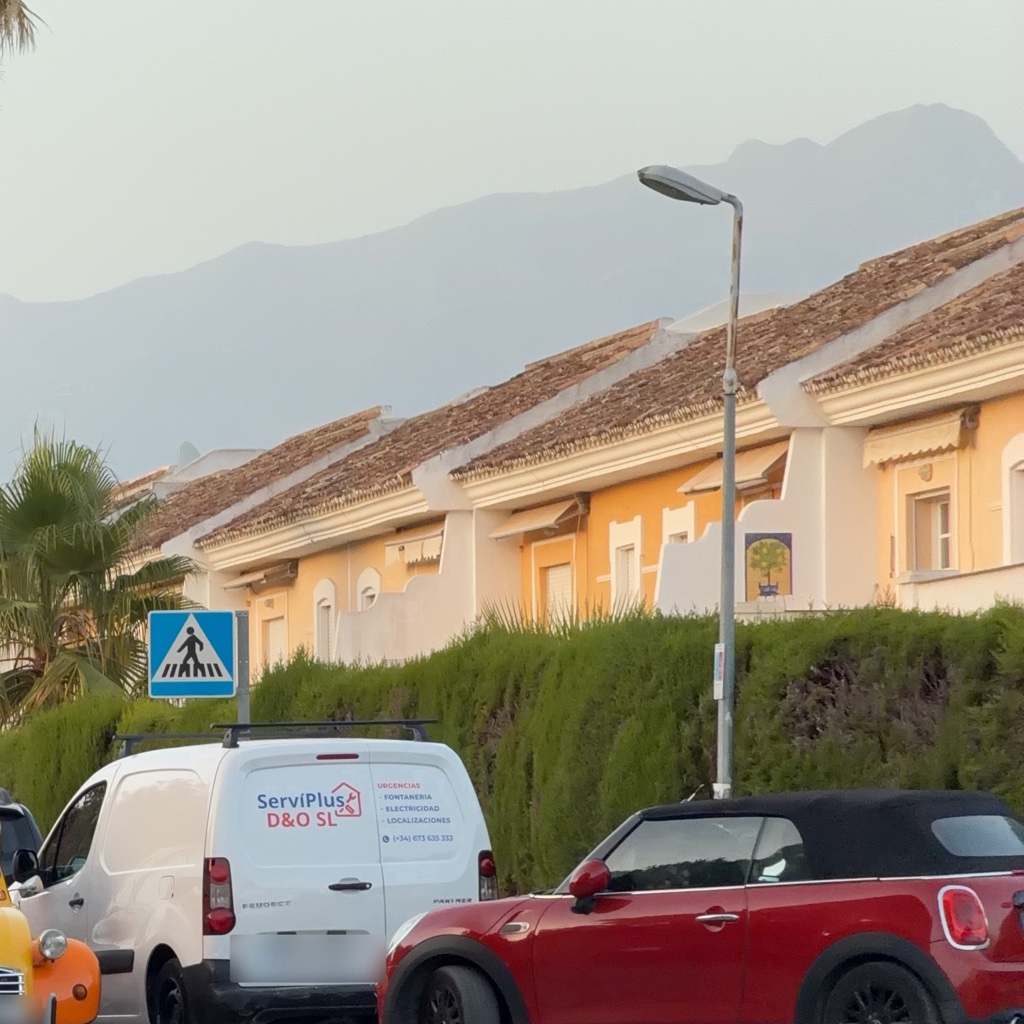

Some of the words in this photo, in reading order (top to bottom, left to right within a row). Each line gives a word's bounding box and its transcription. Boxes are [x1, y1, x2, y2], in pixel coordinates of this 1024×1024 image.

[257, 792, 345, 809] ServíPlus
[267, 812, 310, 828] D&O
[316, 811, 337, 827] SL
[393, 835, 411, 843] (+34)
